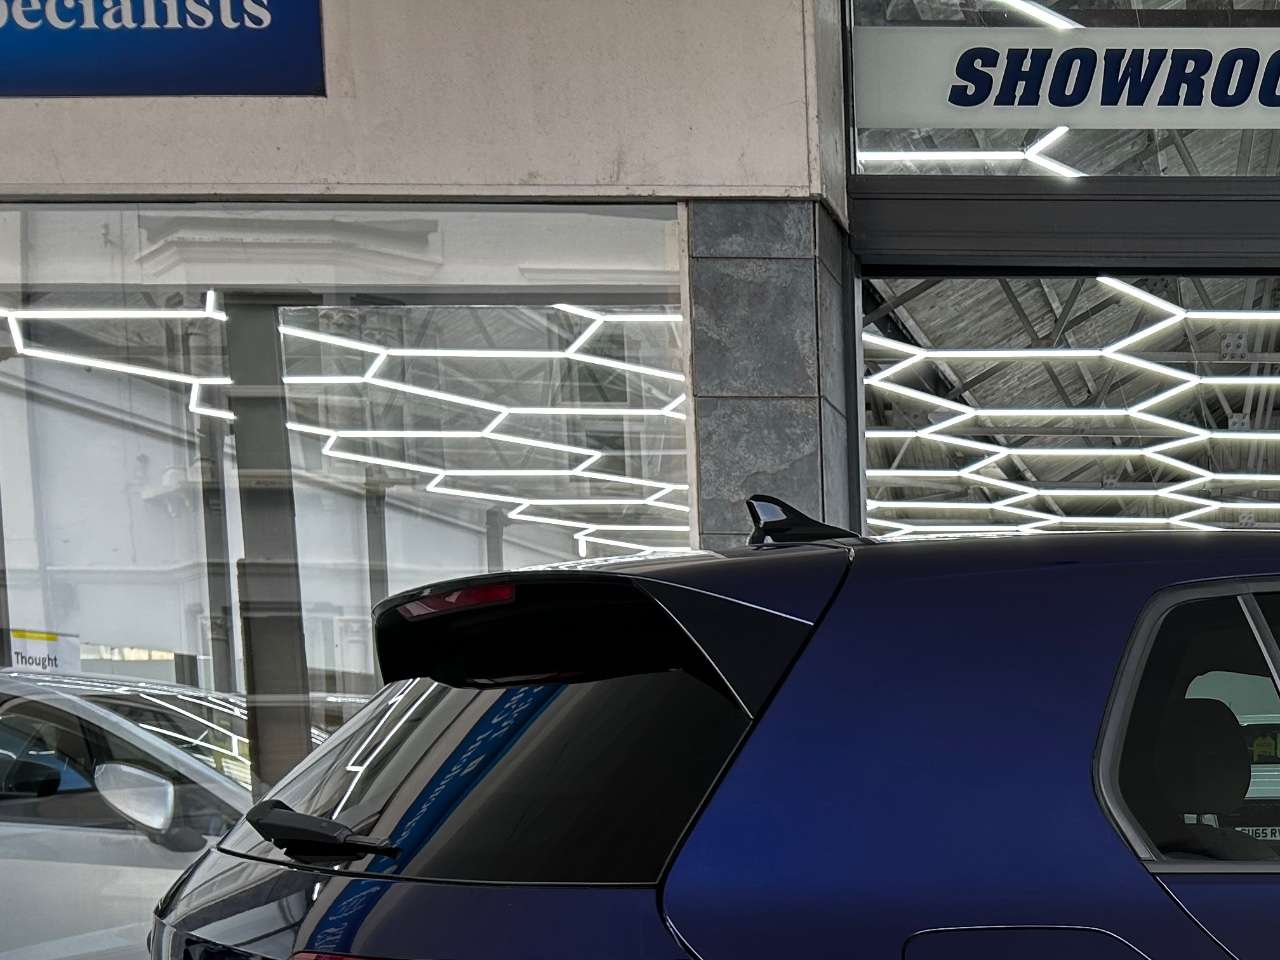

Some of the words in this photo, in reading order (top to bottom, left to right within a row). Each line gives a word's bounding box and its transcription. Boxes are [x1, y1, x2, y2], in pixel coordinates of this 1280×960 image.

[0, 0, 272, 29] ecialists
[14, 651, 58, 670] Thought
[1241, 828, 1268, 839] U65
